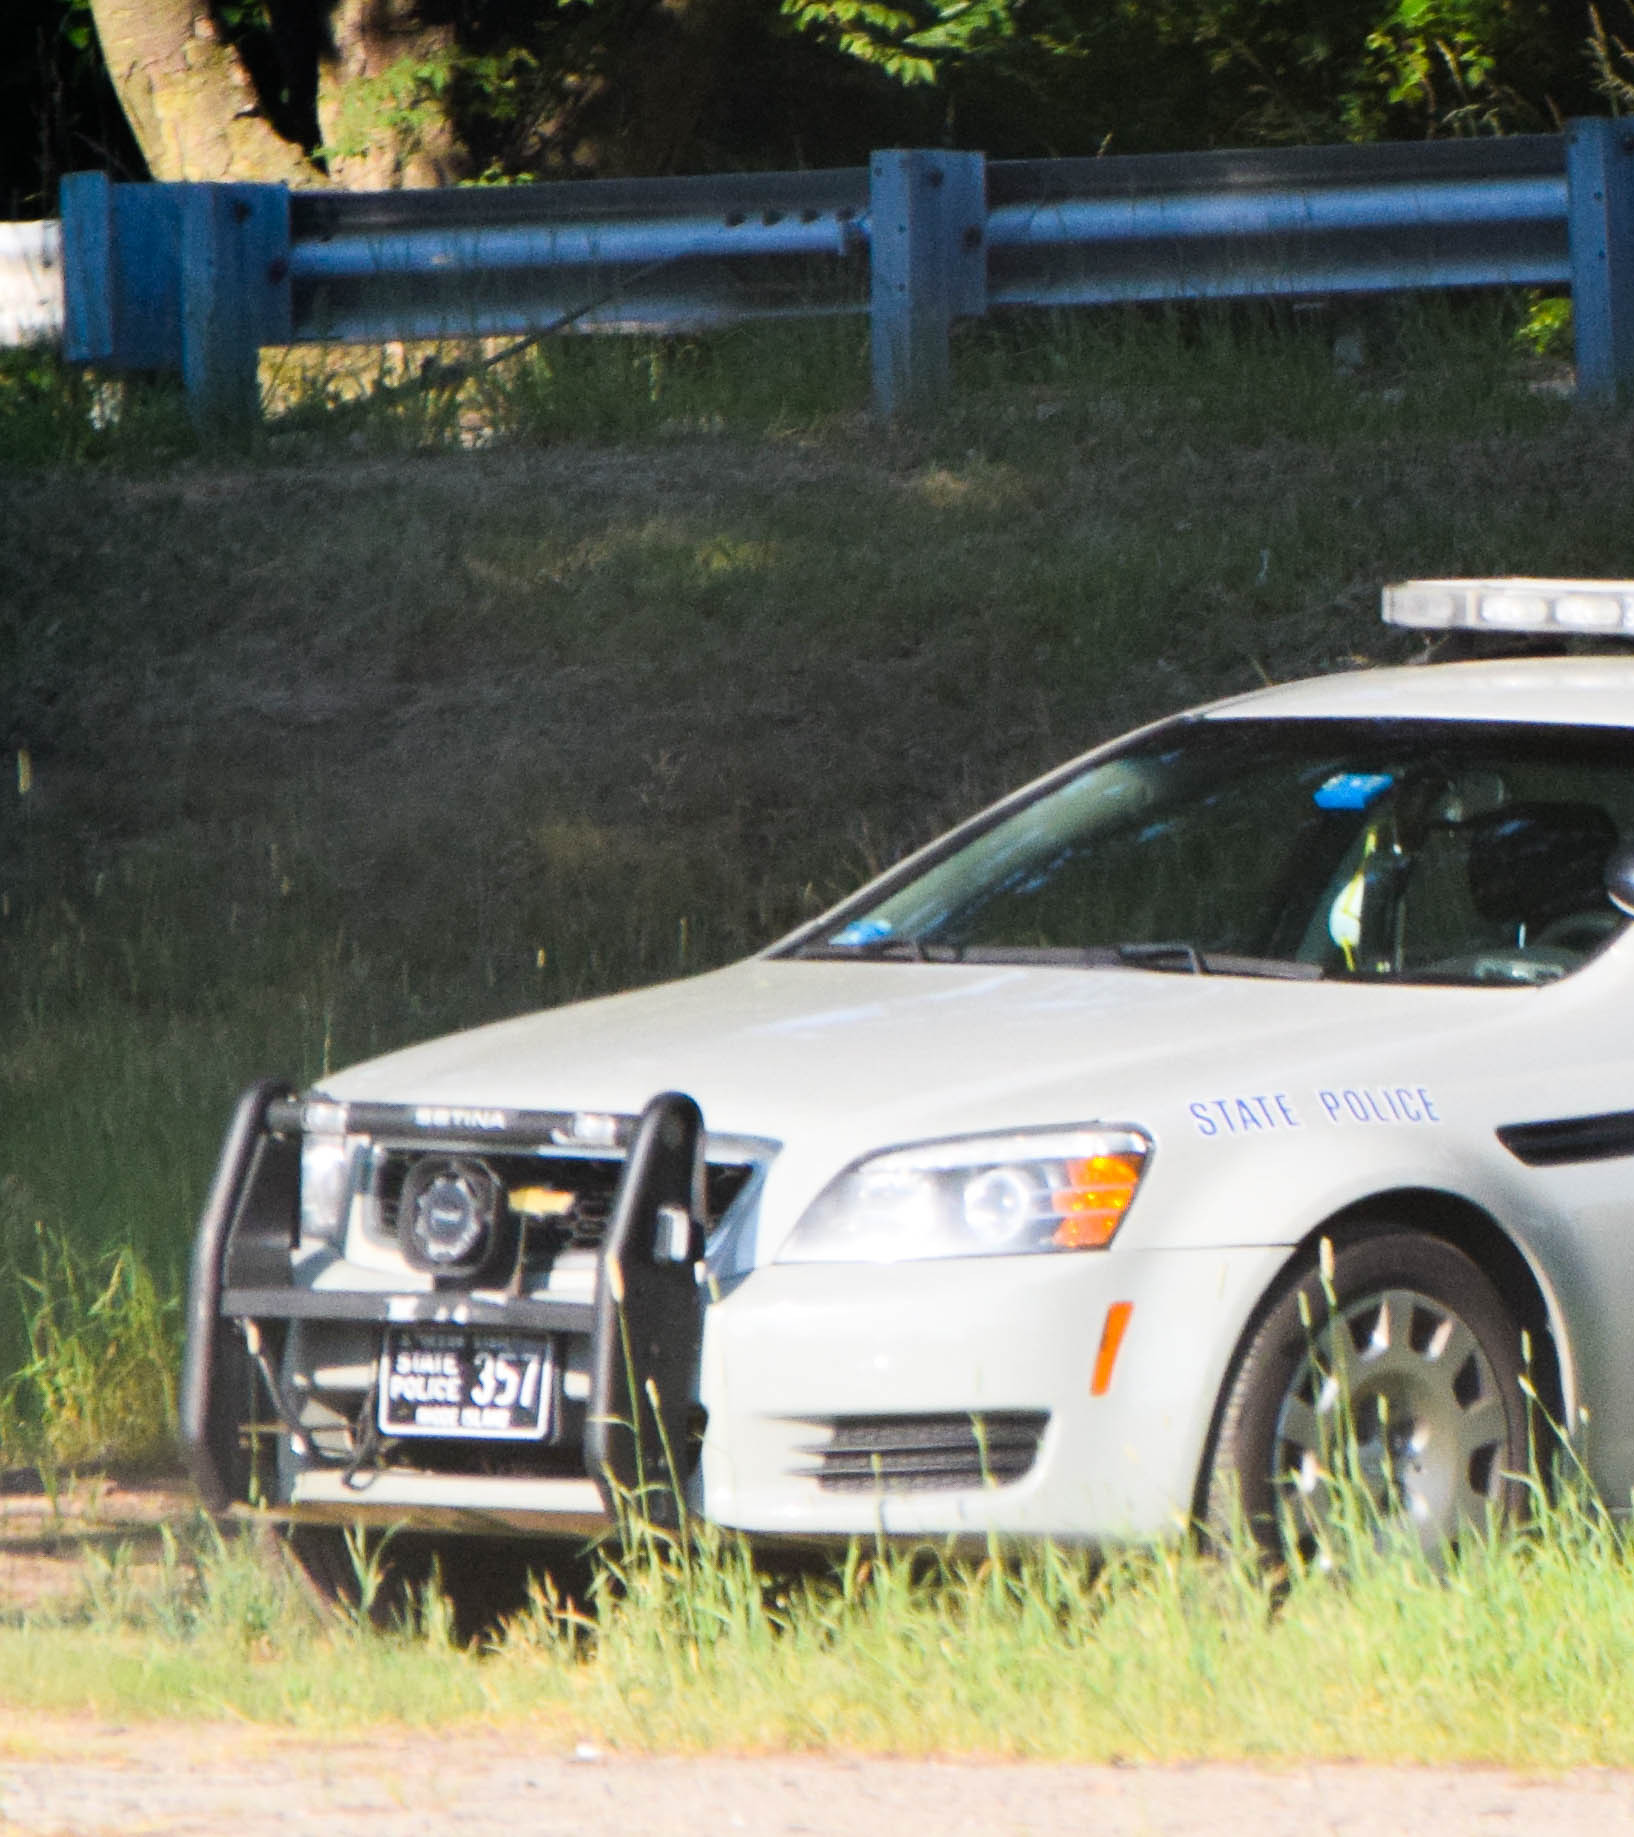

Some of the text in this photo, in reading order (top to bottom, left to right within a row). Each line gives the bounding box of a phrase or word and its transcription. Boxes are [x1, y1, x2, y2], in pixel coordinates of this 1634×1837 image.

[1189, 1087, 1441, 1136] STATE POLICE
[395, 1351, 460, 1375] STATE
[469, 1352, 541, 1409] 357
[389, 1374, 463, 1403] POLICE
